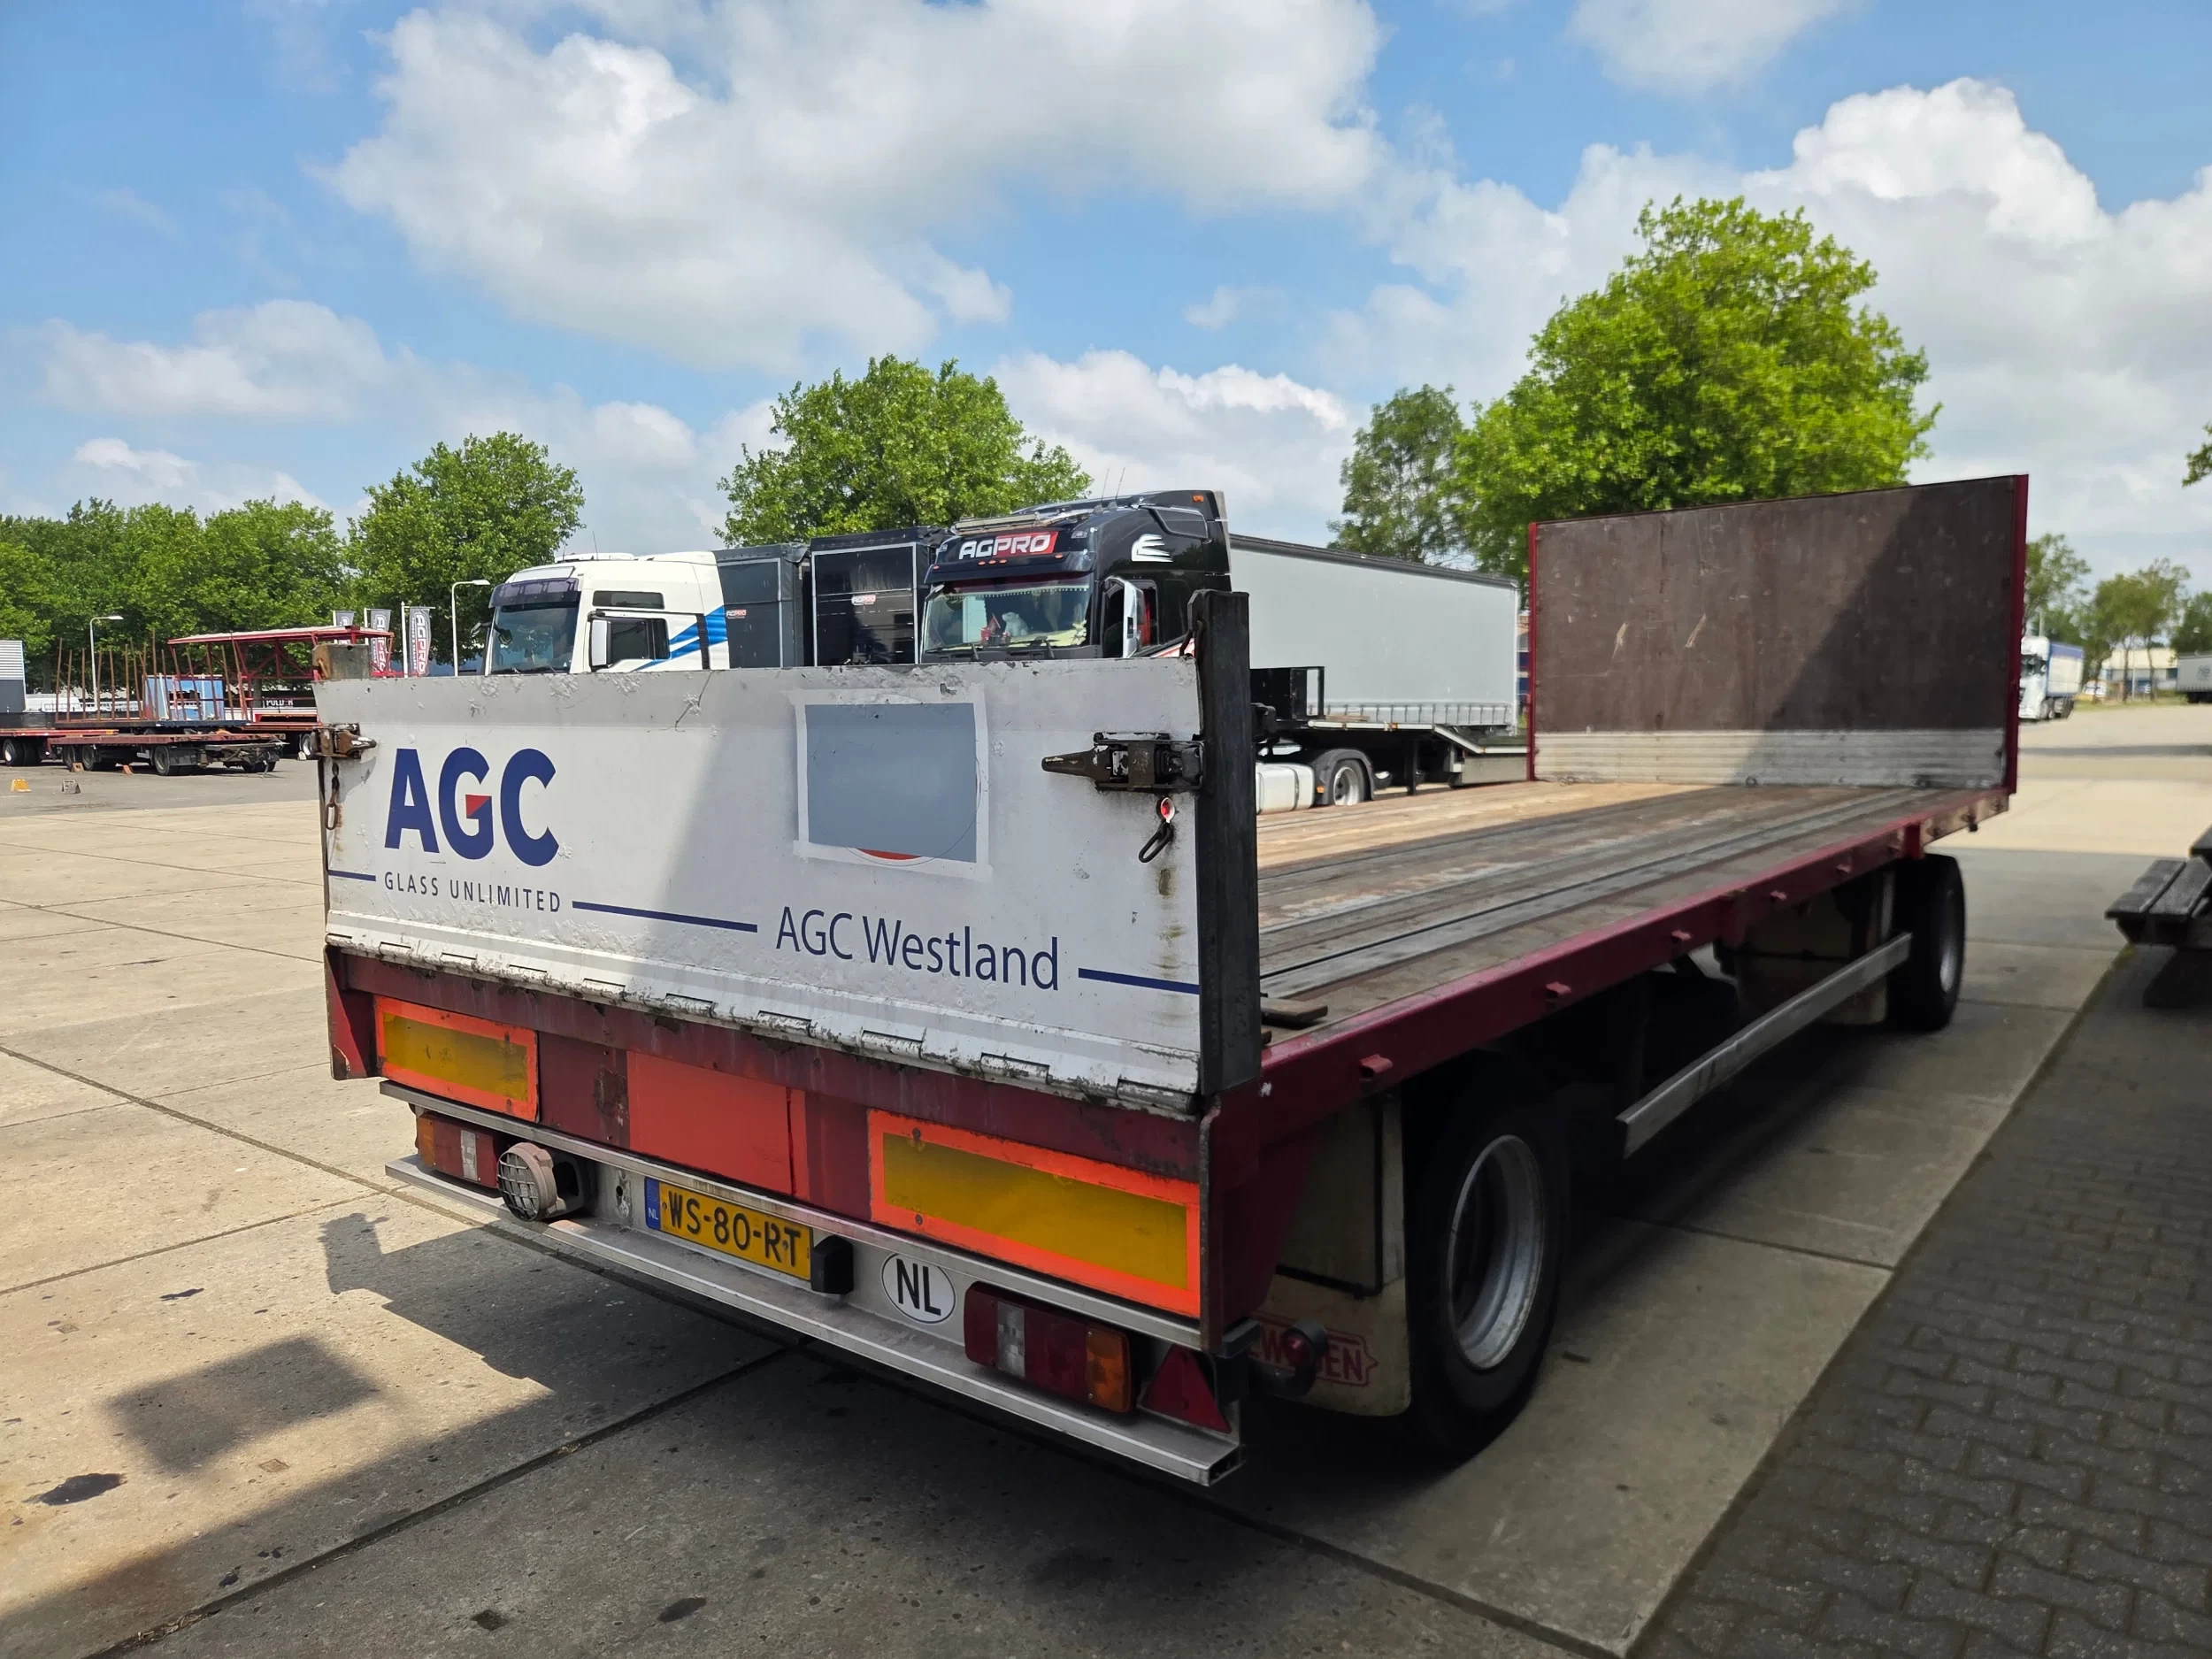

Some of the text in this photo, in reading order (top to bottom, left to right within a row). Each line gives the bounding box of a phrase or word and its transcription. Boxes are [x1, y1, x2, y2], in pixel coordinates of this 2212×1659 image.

[959, 534, 1051, 560] AGPRO
[416, 614, 427, 673] AGPRO
[384, 747, 559, 867] AGC
[384, 871, 561, 913] GLASS UNLIMITED
[775, 905, 1059, 991] AGC Westland
[648, 1207, 659, 1220] NL
[667, 1189, 802, 1267] WS-80-RT
[895, 1258, 942, 1317] NL
